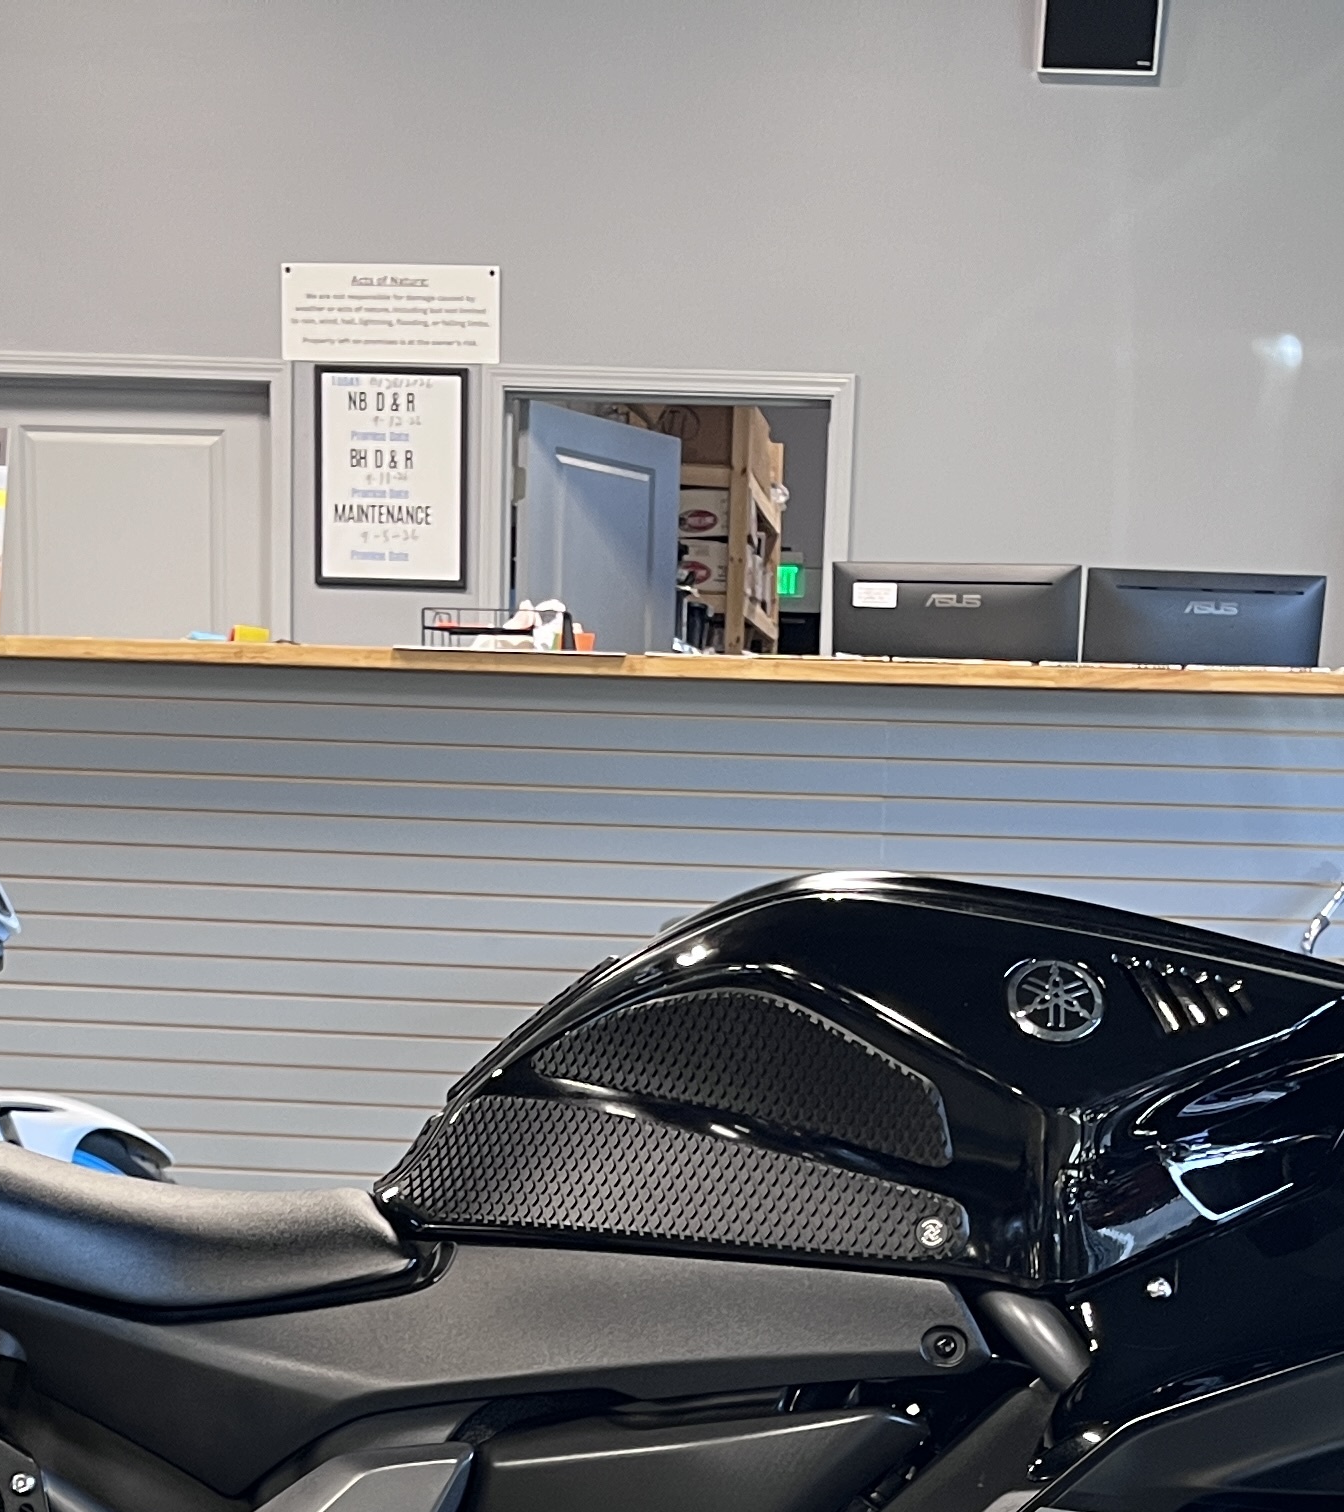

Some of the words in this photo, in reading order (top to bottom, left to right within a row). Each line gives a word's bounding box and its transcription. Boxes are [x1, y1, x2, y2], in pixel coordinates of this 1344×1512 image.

[376, 391, 385, 412] D
[375, 449, 384, 468] D
[333, 503, 432, 525] MAINTENANCE
[925, 594, 982, 608] ASUS
[1184, 601, 1238, 616] ASUS
